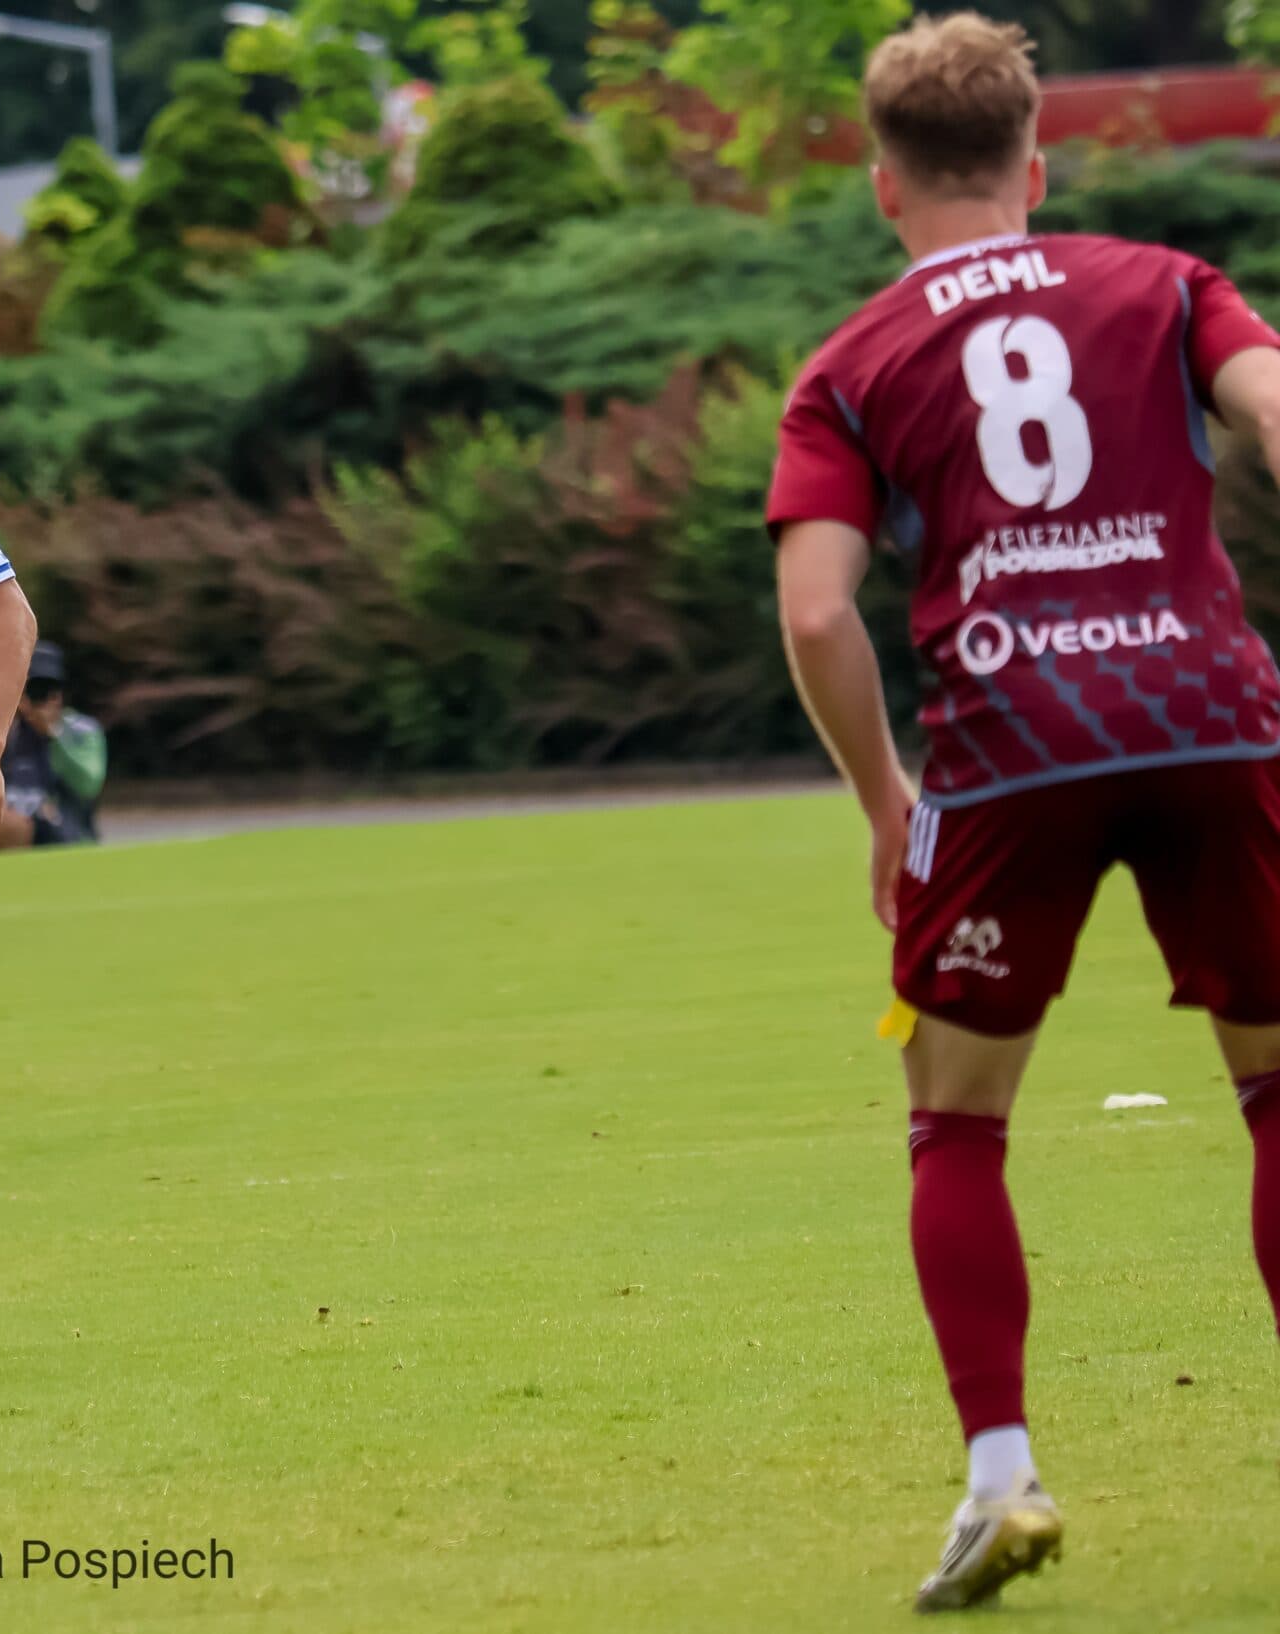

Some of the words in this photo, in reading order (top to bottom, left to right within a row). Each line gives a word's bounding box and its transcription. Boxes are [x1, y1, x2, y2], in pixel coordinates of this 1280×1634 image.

[924, 250, 1066, 316] DEML
[962, 315, 1093, 512] 8
[1020, 610, 1190, 657] VEOLIA
